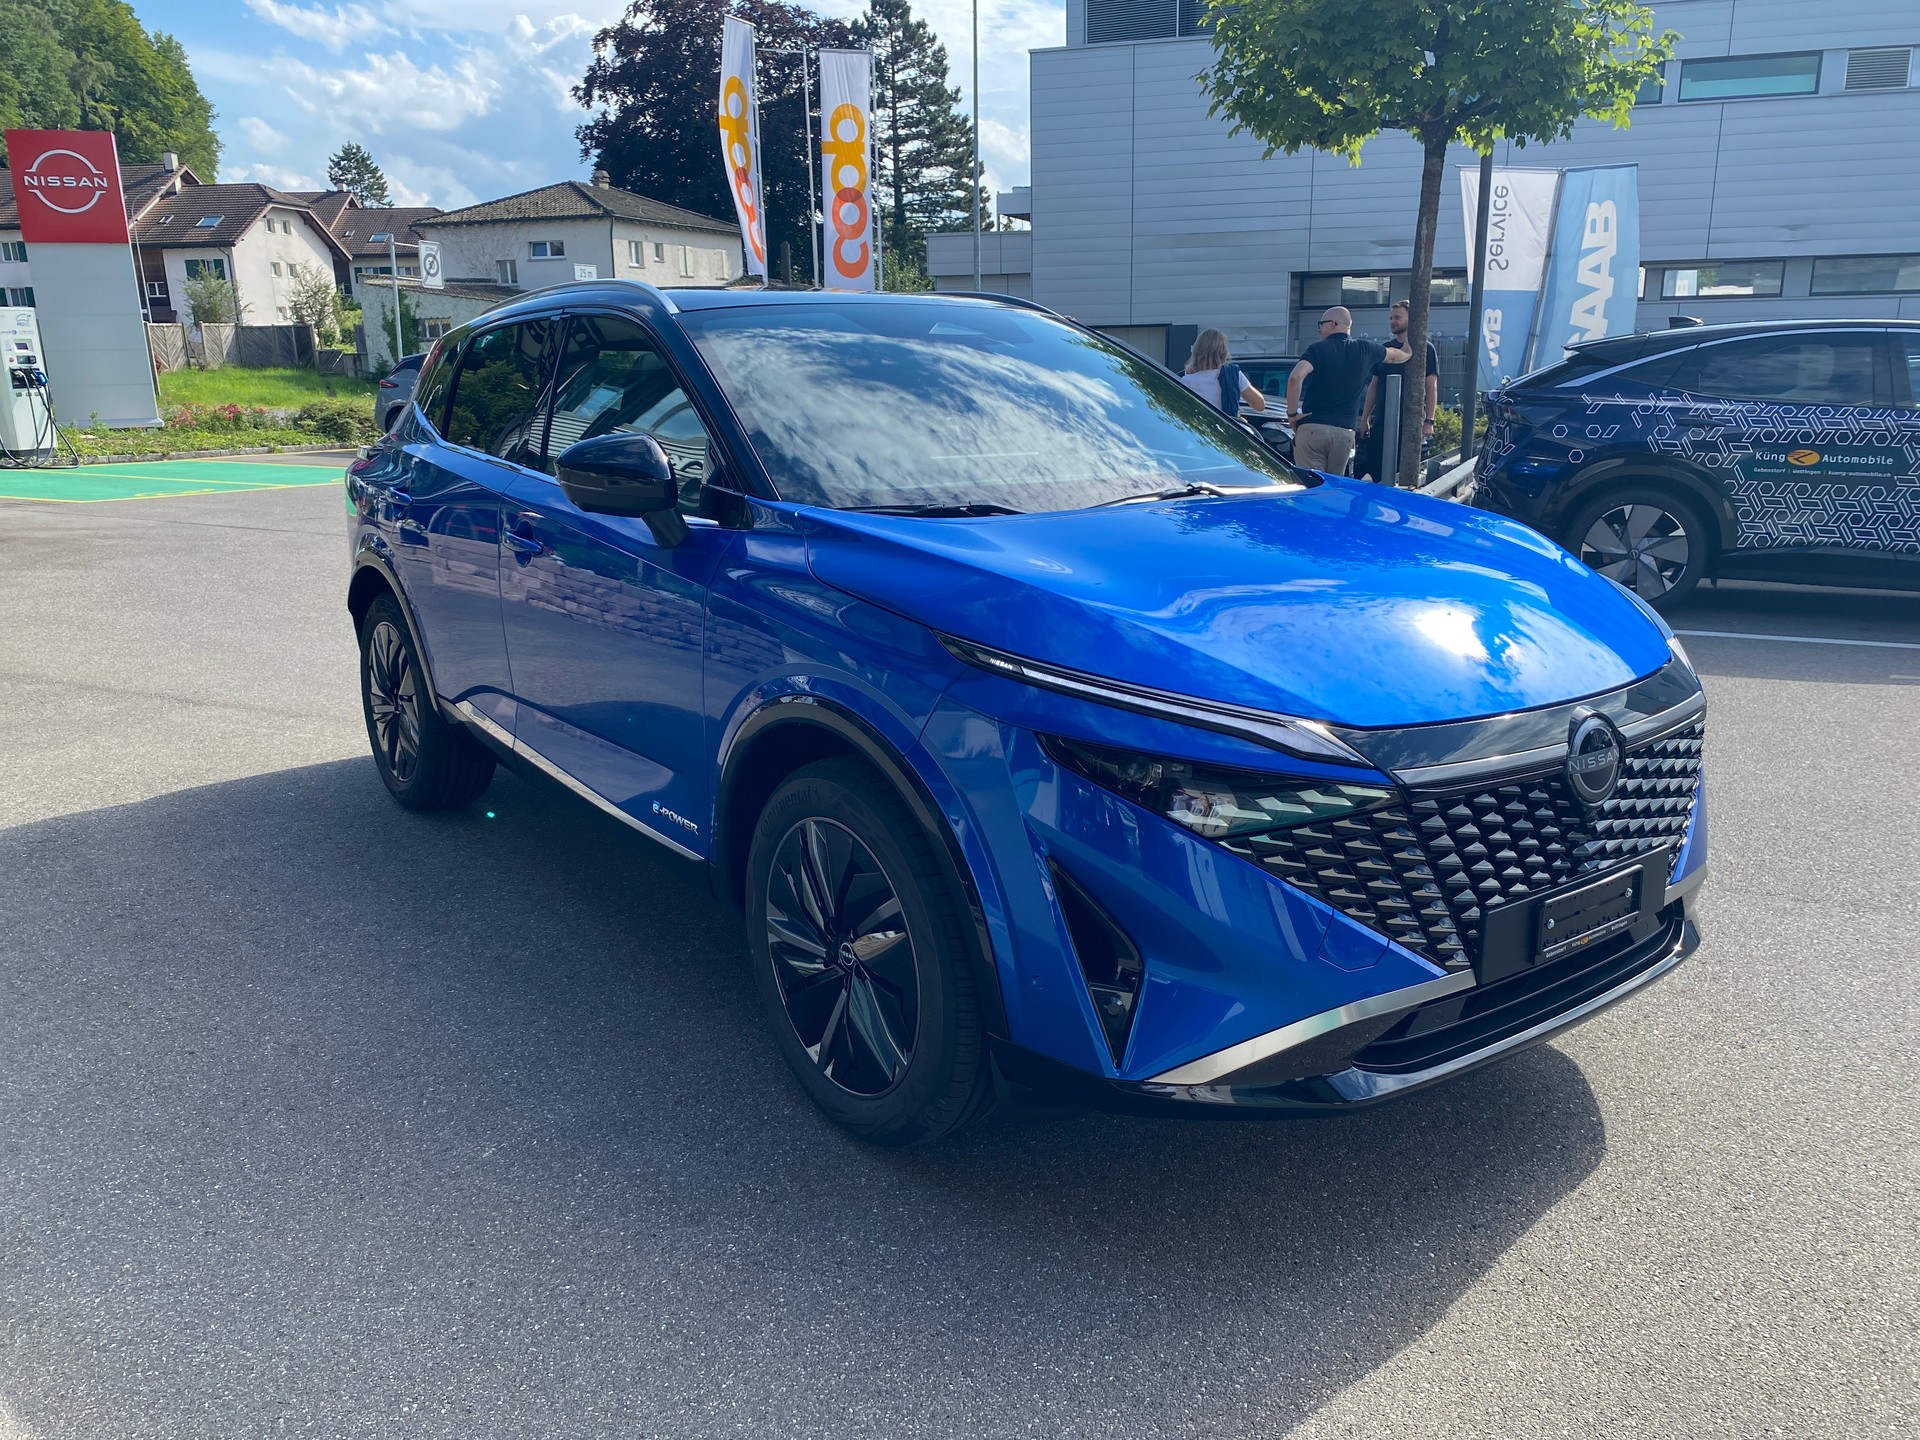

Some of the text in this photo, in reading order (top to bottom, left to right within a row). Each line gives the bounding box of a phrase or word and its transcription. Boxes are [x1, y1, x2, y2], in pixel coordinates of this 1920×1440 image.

[23, 175, 109, 188] NISSAN
[719, 76, 764, 265] coop
[821, 103, 869, 279] coop
[1755, 451, 1894, 465] Küng Automobile
[989, 658, 1013, 670] NISSAN
[1568, 748, 1619, 772] NISSAN
[652, 800, 699, 836] e-POWER
[761, 784, 812, 834] Continental
